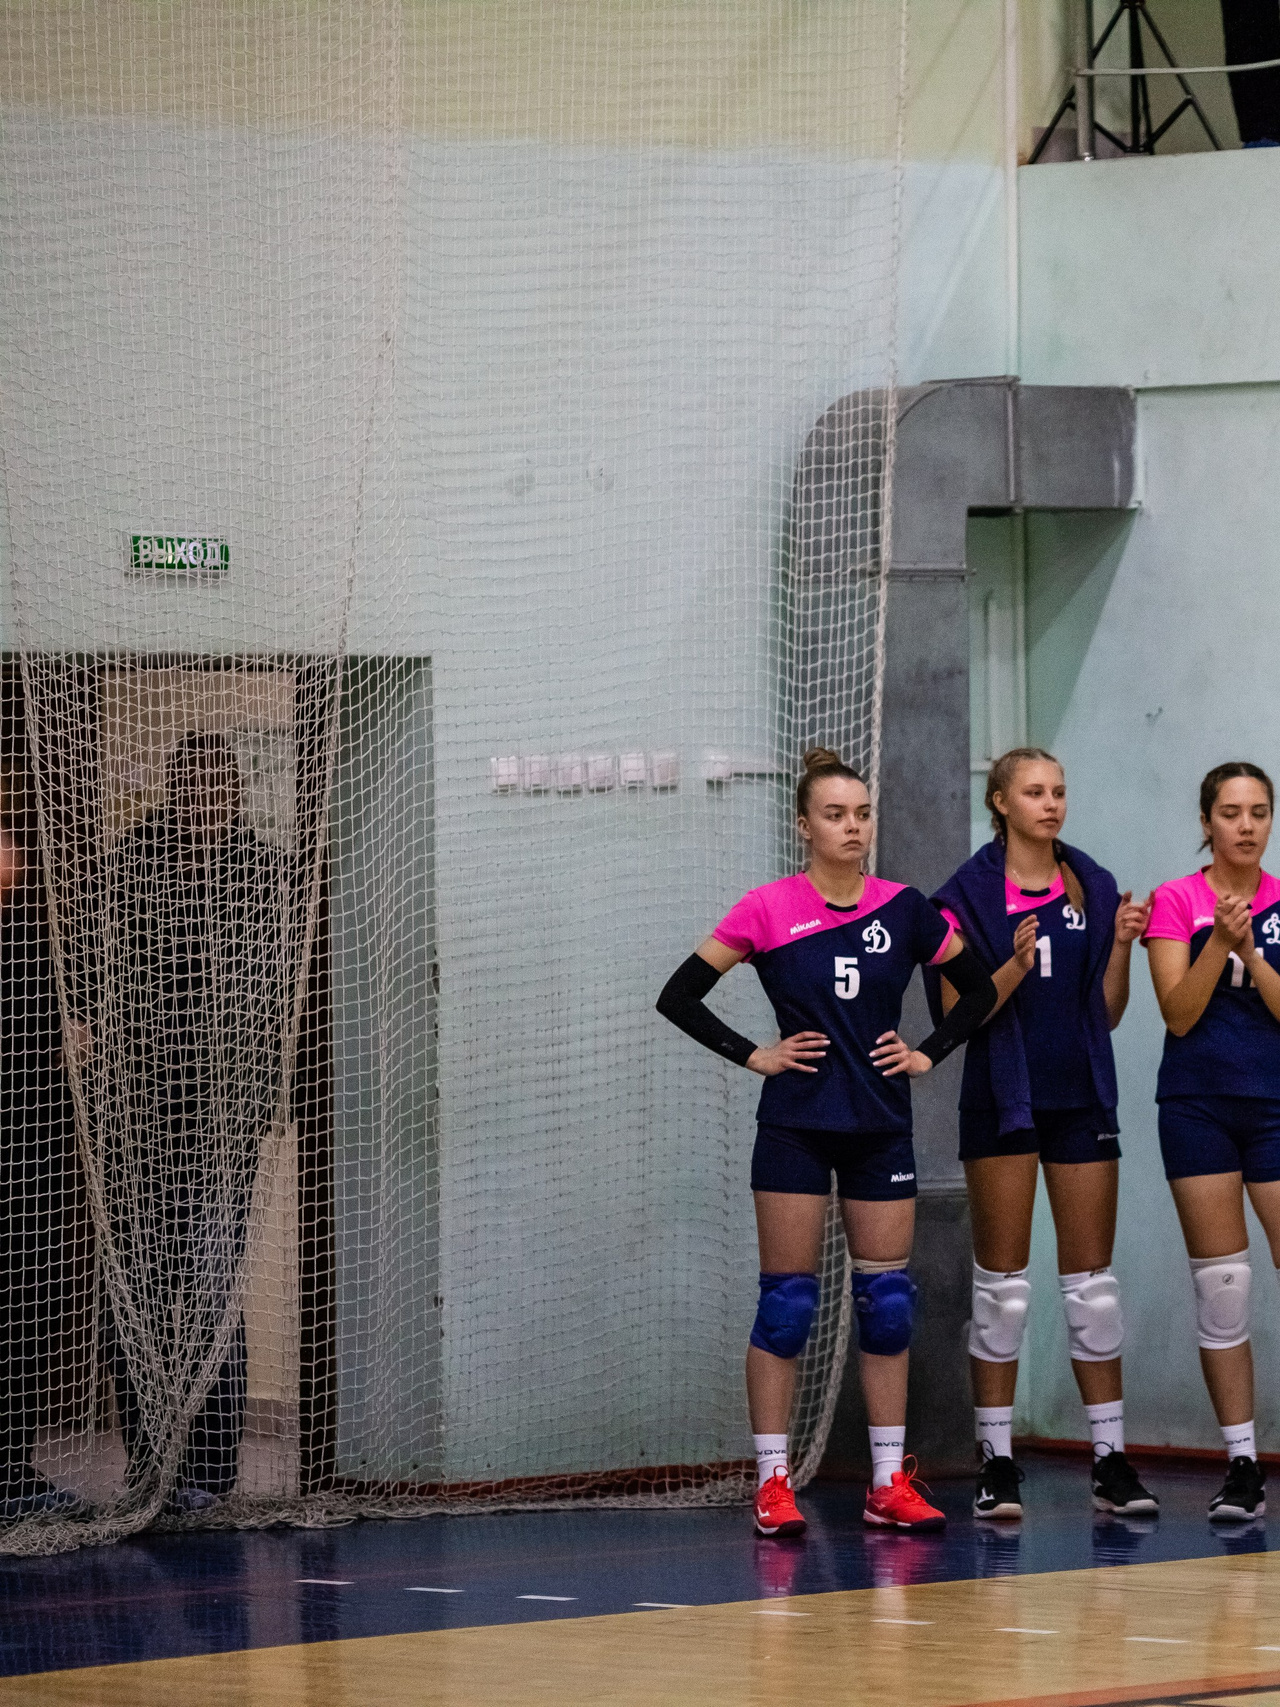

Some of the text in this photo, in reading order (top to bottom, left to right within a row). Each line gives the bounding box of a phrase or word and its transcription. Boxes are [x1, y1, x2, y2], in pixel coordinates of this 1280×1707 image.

[139, 541, 221, 567] ВЫХОД
[1035, 935, 1052, 977] 1
[834, 956, 860, 1000] 5
